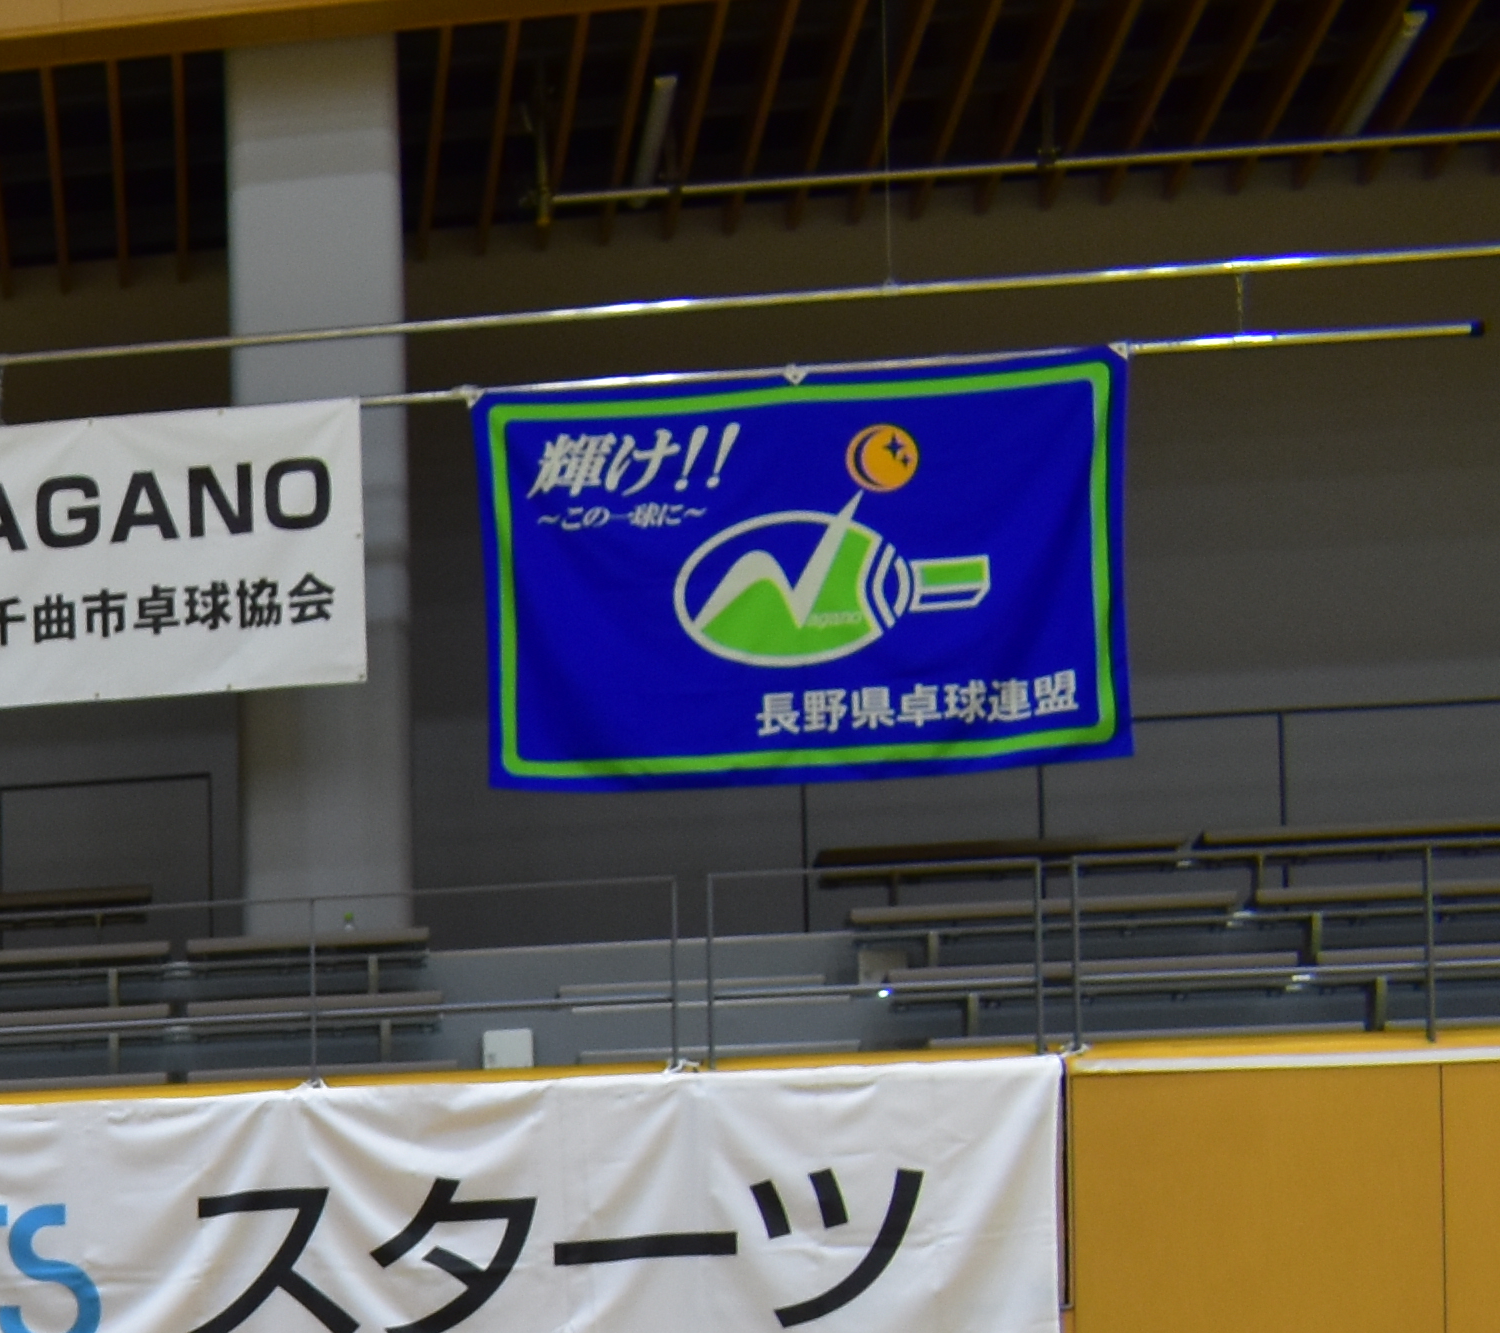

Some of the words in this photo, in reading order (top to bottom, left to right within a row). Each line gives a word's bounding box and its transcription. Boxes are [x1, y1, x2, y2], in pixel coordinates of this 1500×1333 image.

[756, 668, 1080, 737] 長野県卓球連盟
